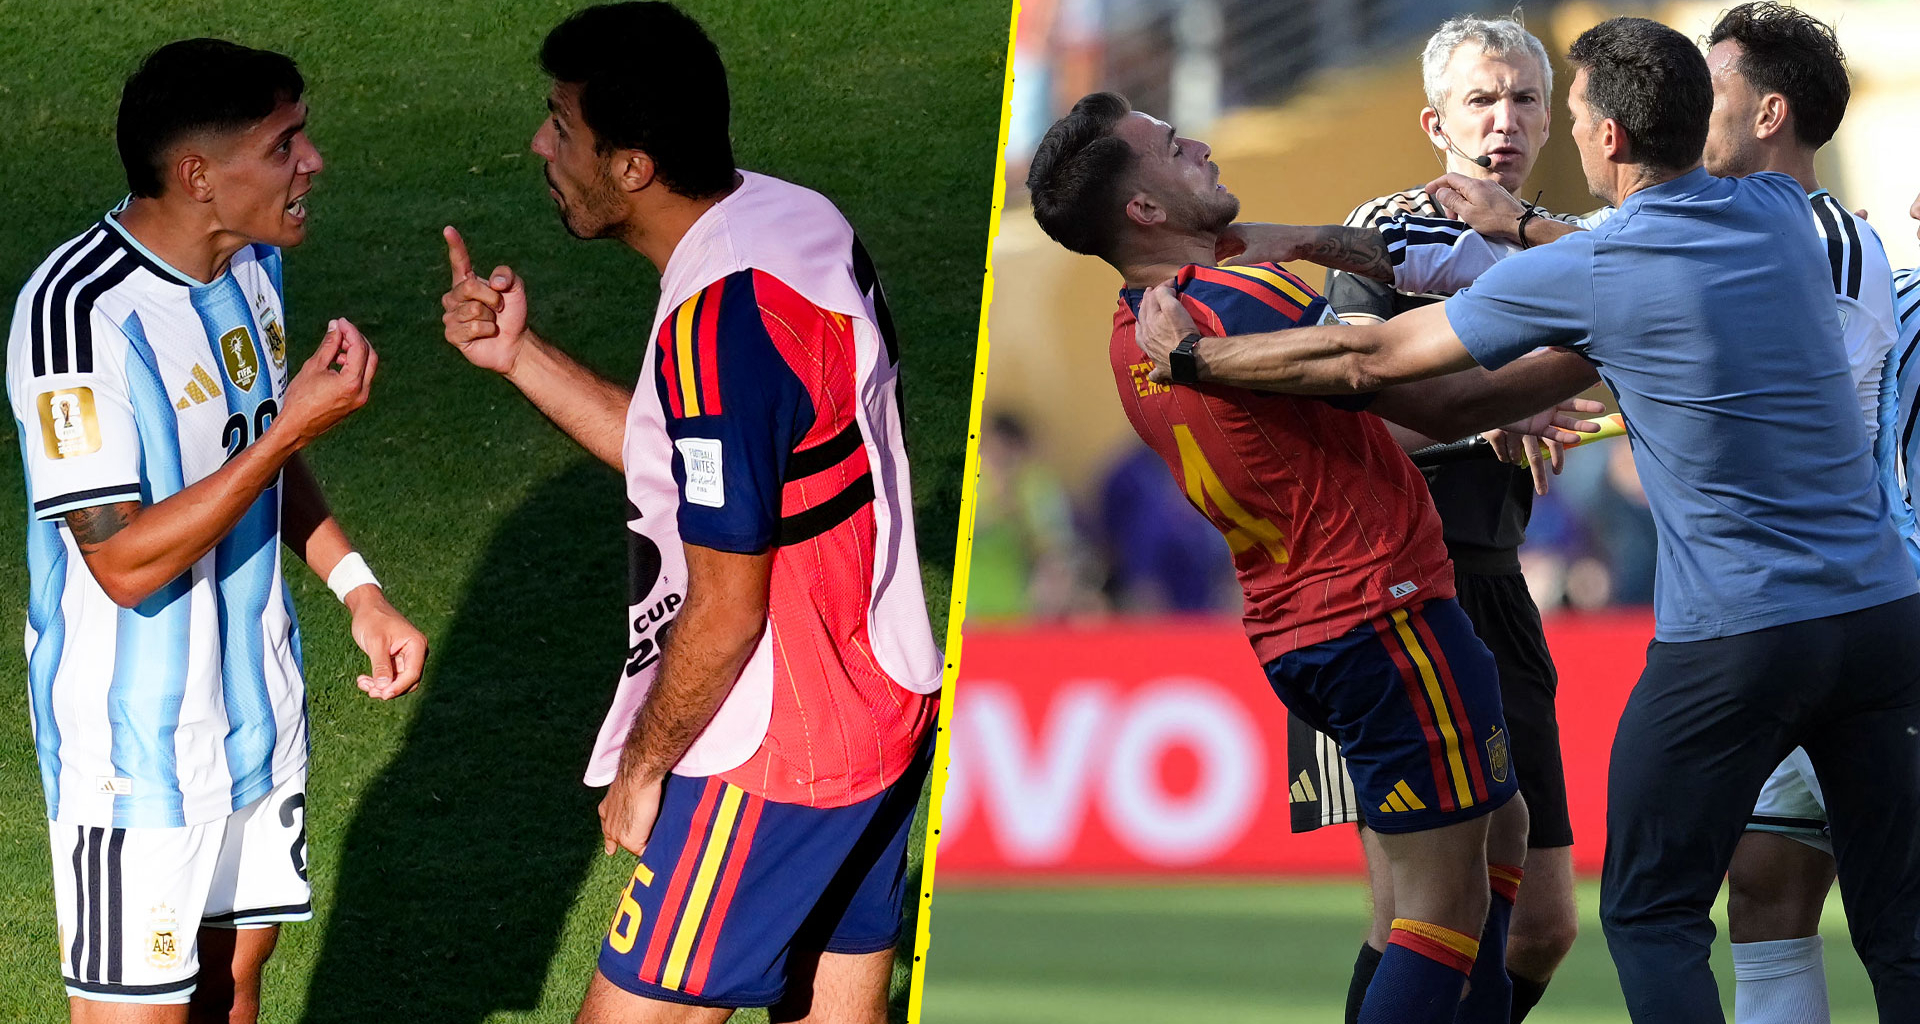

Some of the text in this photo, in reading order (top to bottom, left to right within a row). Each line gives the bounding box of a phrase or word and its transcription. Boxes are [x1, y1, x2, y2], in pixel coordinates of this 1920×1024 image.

[237, 366, 253, 381] FIFA
[690, 458, 716, 475] UNITES
[1172, 424, 1290, 565] 4
[633, 593, 682, 634] CUP
[153, 931, 176, 956] AFA
